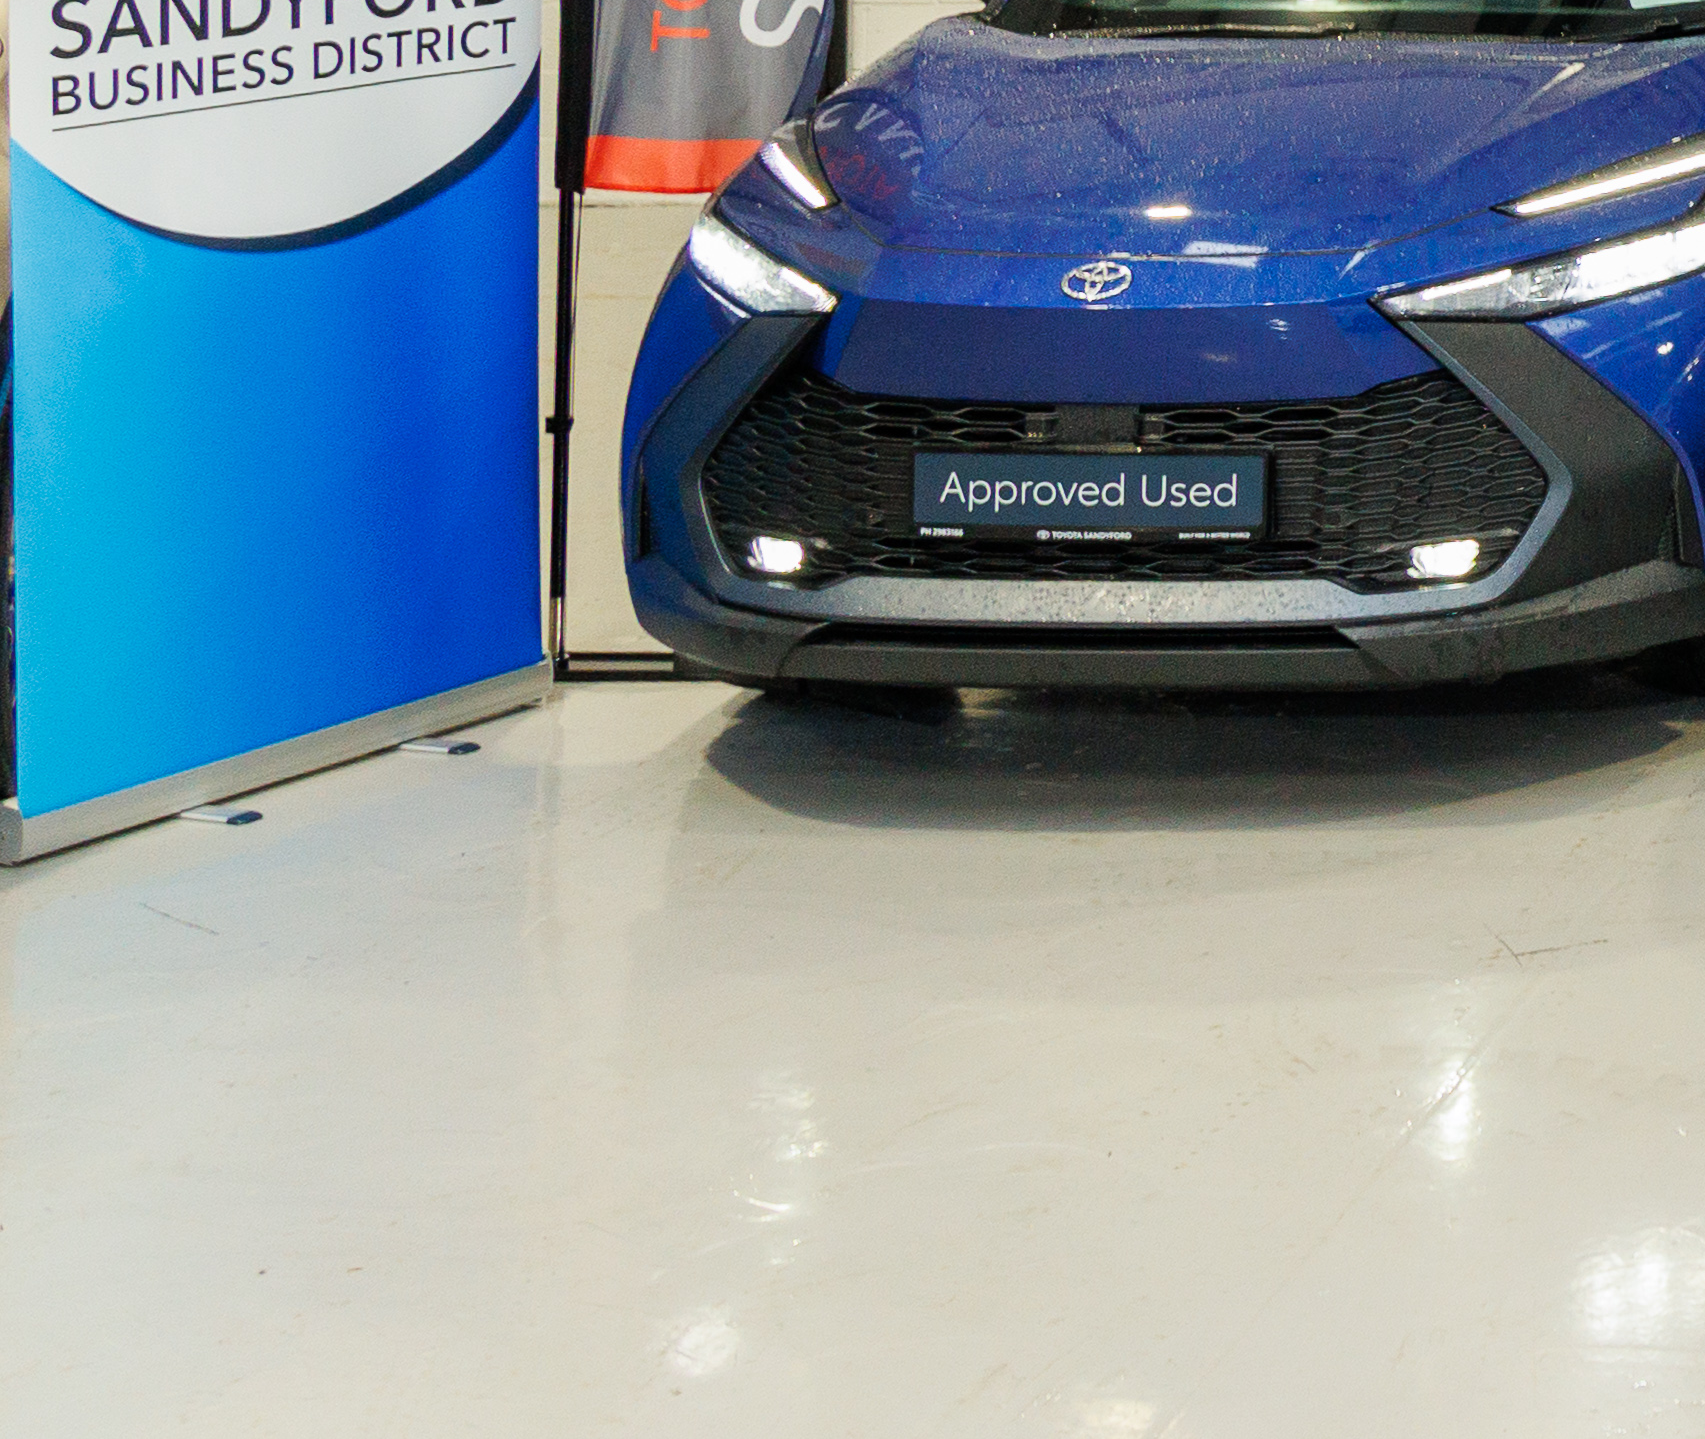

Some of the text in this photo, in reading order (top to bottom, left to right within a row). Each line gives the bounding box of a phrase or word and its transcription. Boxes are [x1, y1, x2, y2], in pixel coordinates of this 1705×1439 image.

[52, 17, 517, 116] BUSINESS DISTRICT
[939, 472, 1237, 513] Approved Used
